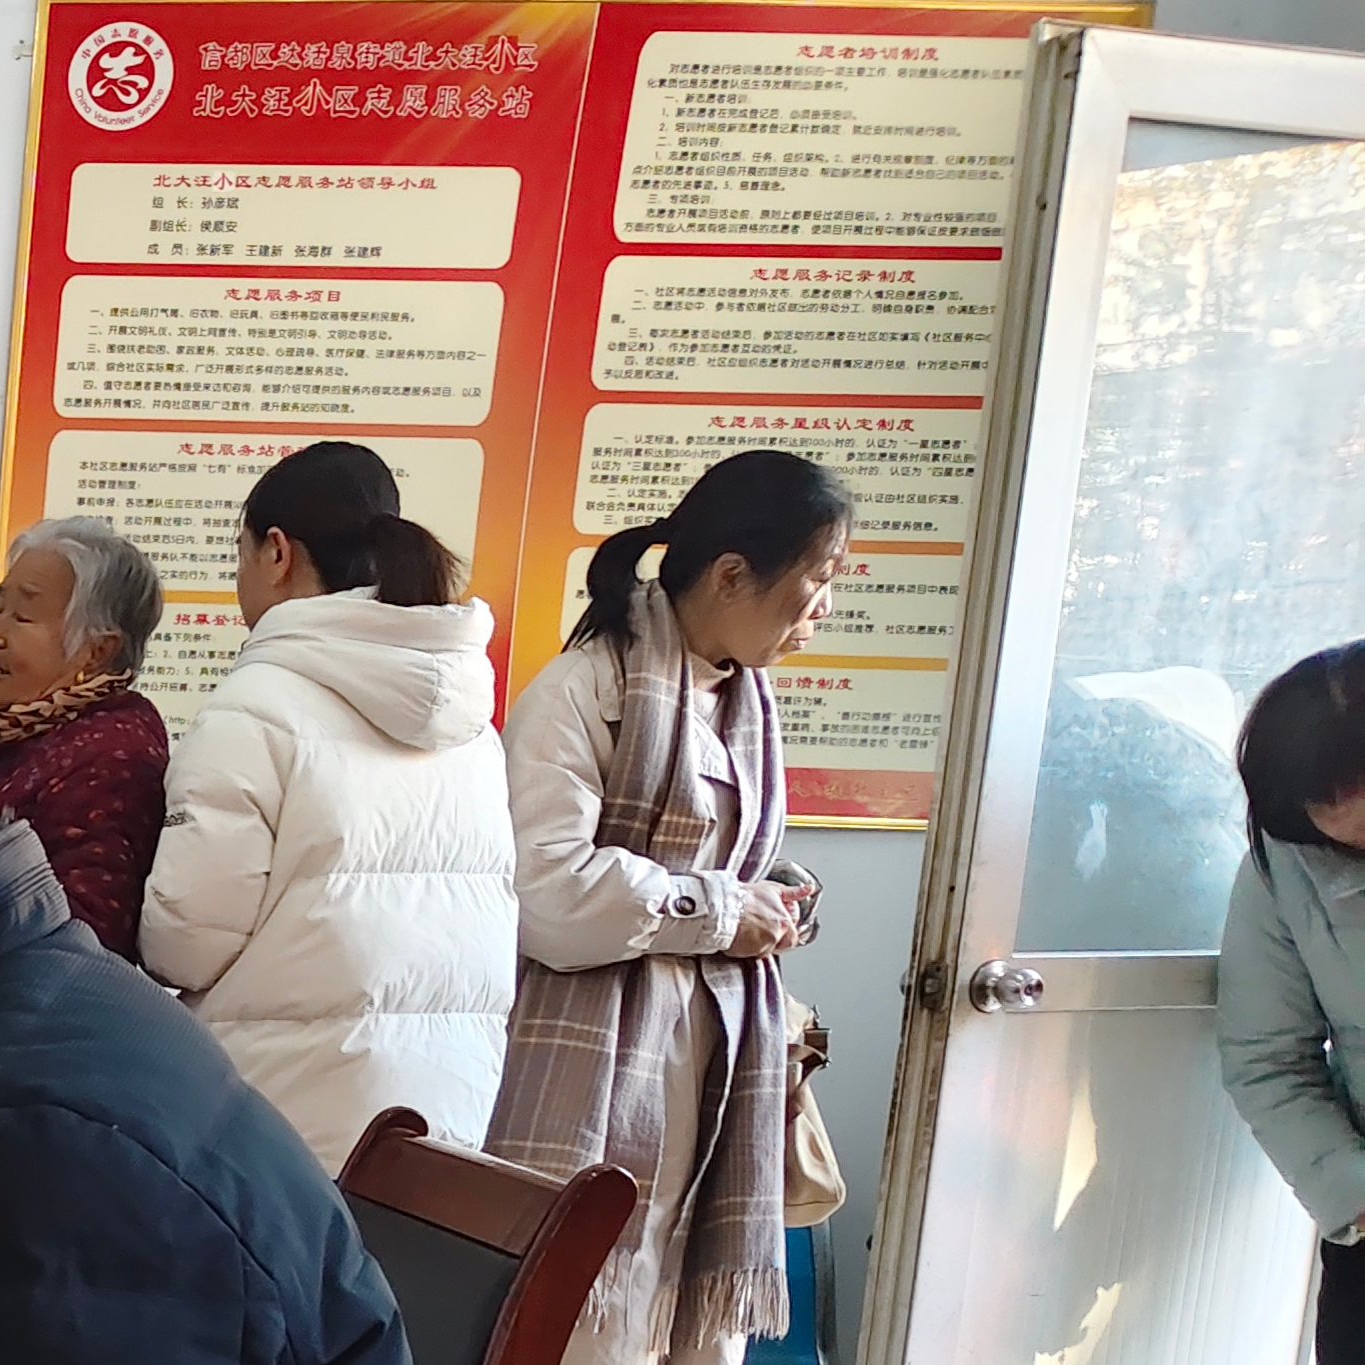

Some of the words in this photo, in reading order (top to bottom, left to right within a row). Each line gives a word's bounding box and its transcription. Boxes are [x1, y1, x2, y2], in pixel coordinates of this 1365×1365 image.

[199, 35, 539, 75] 信都区达活泉街道北大汪小区
[91, 45, 150, 105] 志
[74, 87, 93, 115] China
[93, 111, 136, 126] Volunteer
[137, 88, 165, 118] Service
[192, 78, 534, 119] 北大汪小区志愿服务站
[152, 172, 438, 191] 北大汪小区志愿服务站领导小组
[749, 267, 917, 284] 志愿服务记录制度
[223, 287, 343, 303] 志愿服务项目
[707, 416, 916, 433] 志愿服务星级认定制度
